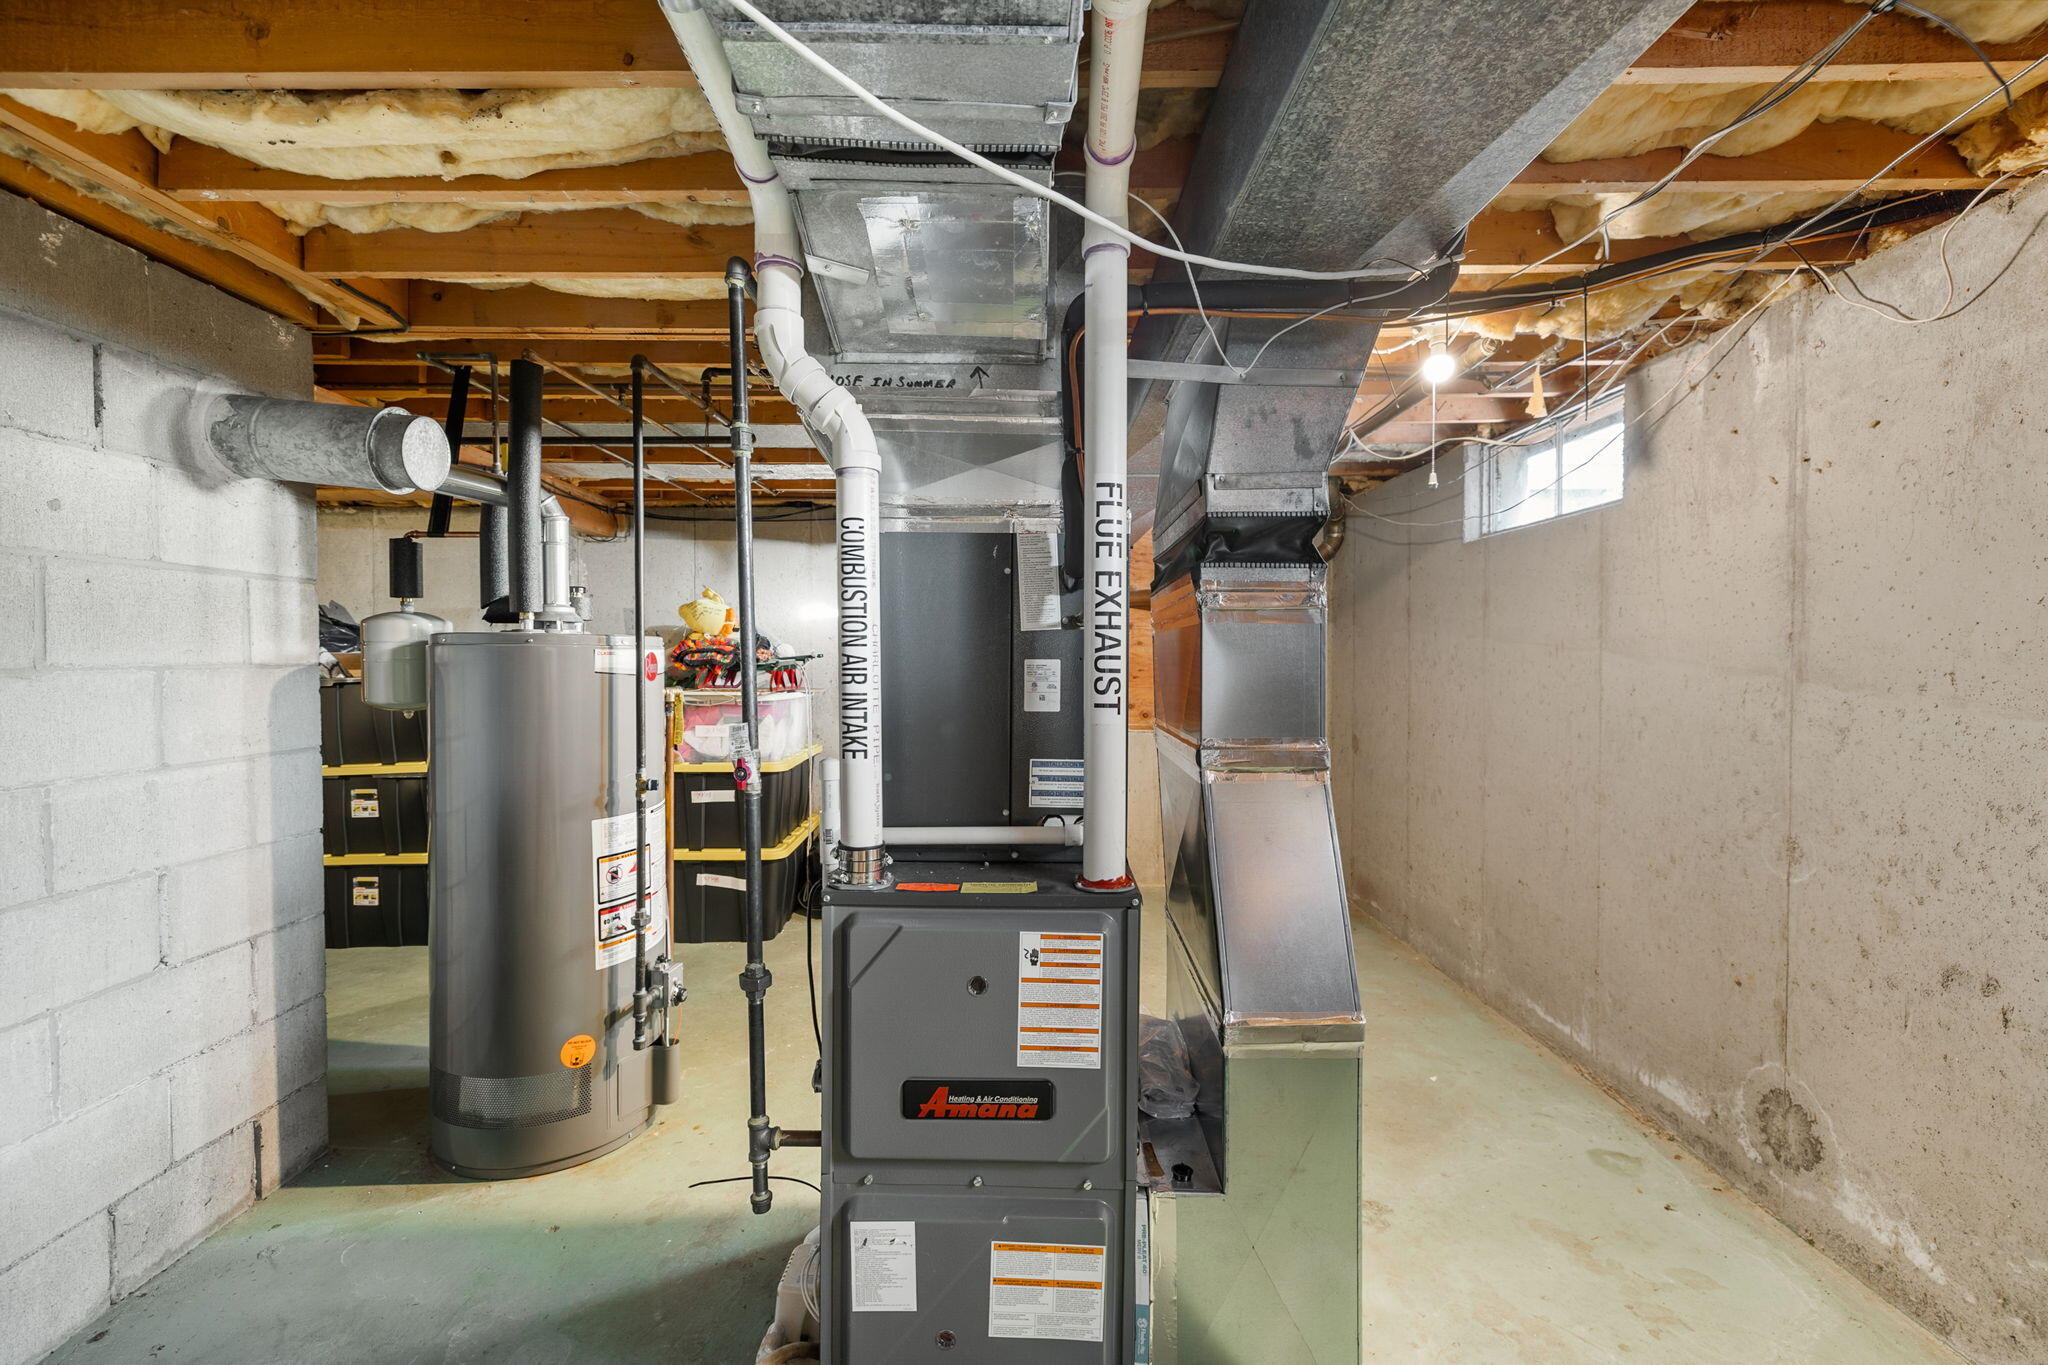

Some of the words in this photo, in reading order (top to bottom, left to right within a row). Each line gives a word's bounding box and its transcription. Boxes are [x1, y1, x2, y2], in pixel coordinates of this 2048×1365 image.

[871, 377, 892, 387] IN
[898, 376, 956, 389] SUMMER
[1095, 482, 1122, 558] FLUE
[841, 517, 868, 647] COMBUSTION
[842, 653, 868, 685] AIR
[872, 624, 880, 713] CHARLOTTE
[1093, 571, 1122, 715] EXHAUST
[842, 692, 868, 760] INTAKE
[873, 724, 881, 766] PIPE
[918, 1086, 1039, 1119] Amana
[948, 1095, 975, 1103] Heating
[994, 1096, 1039, 1104] Conditioning
